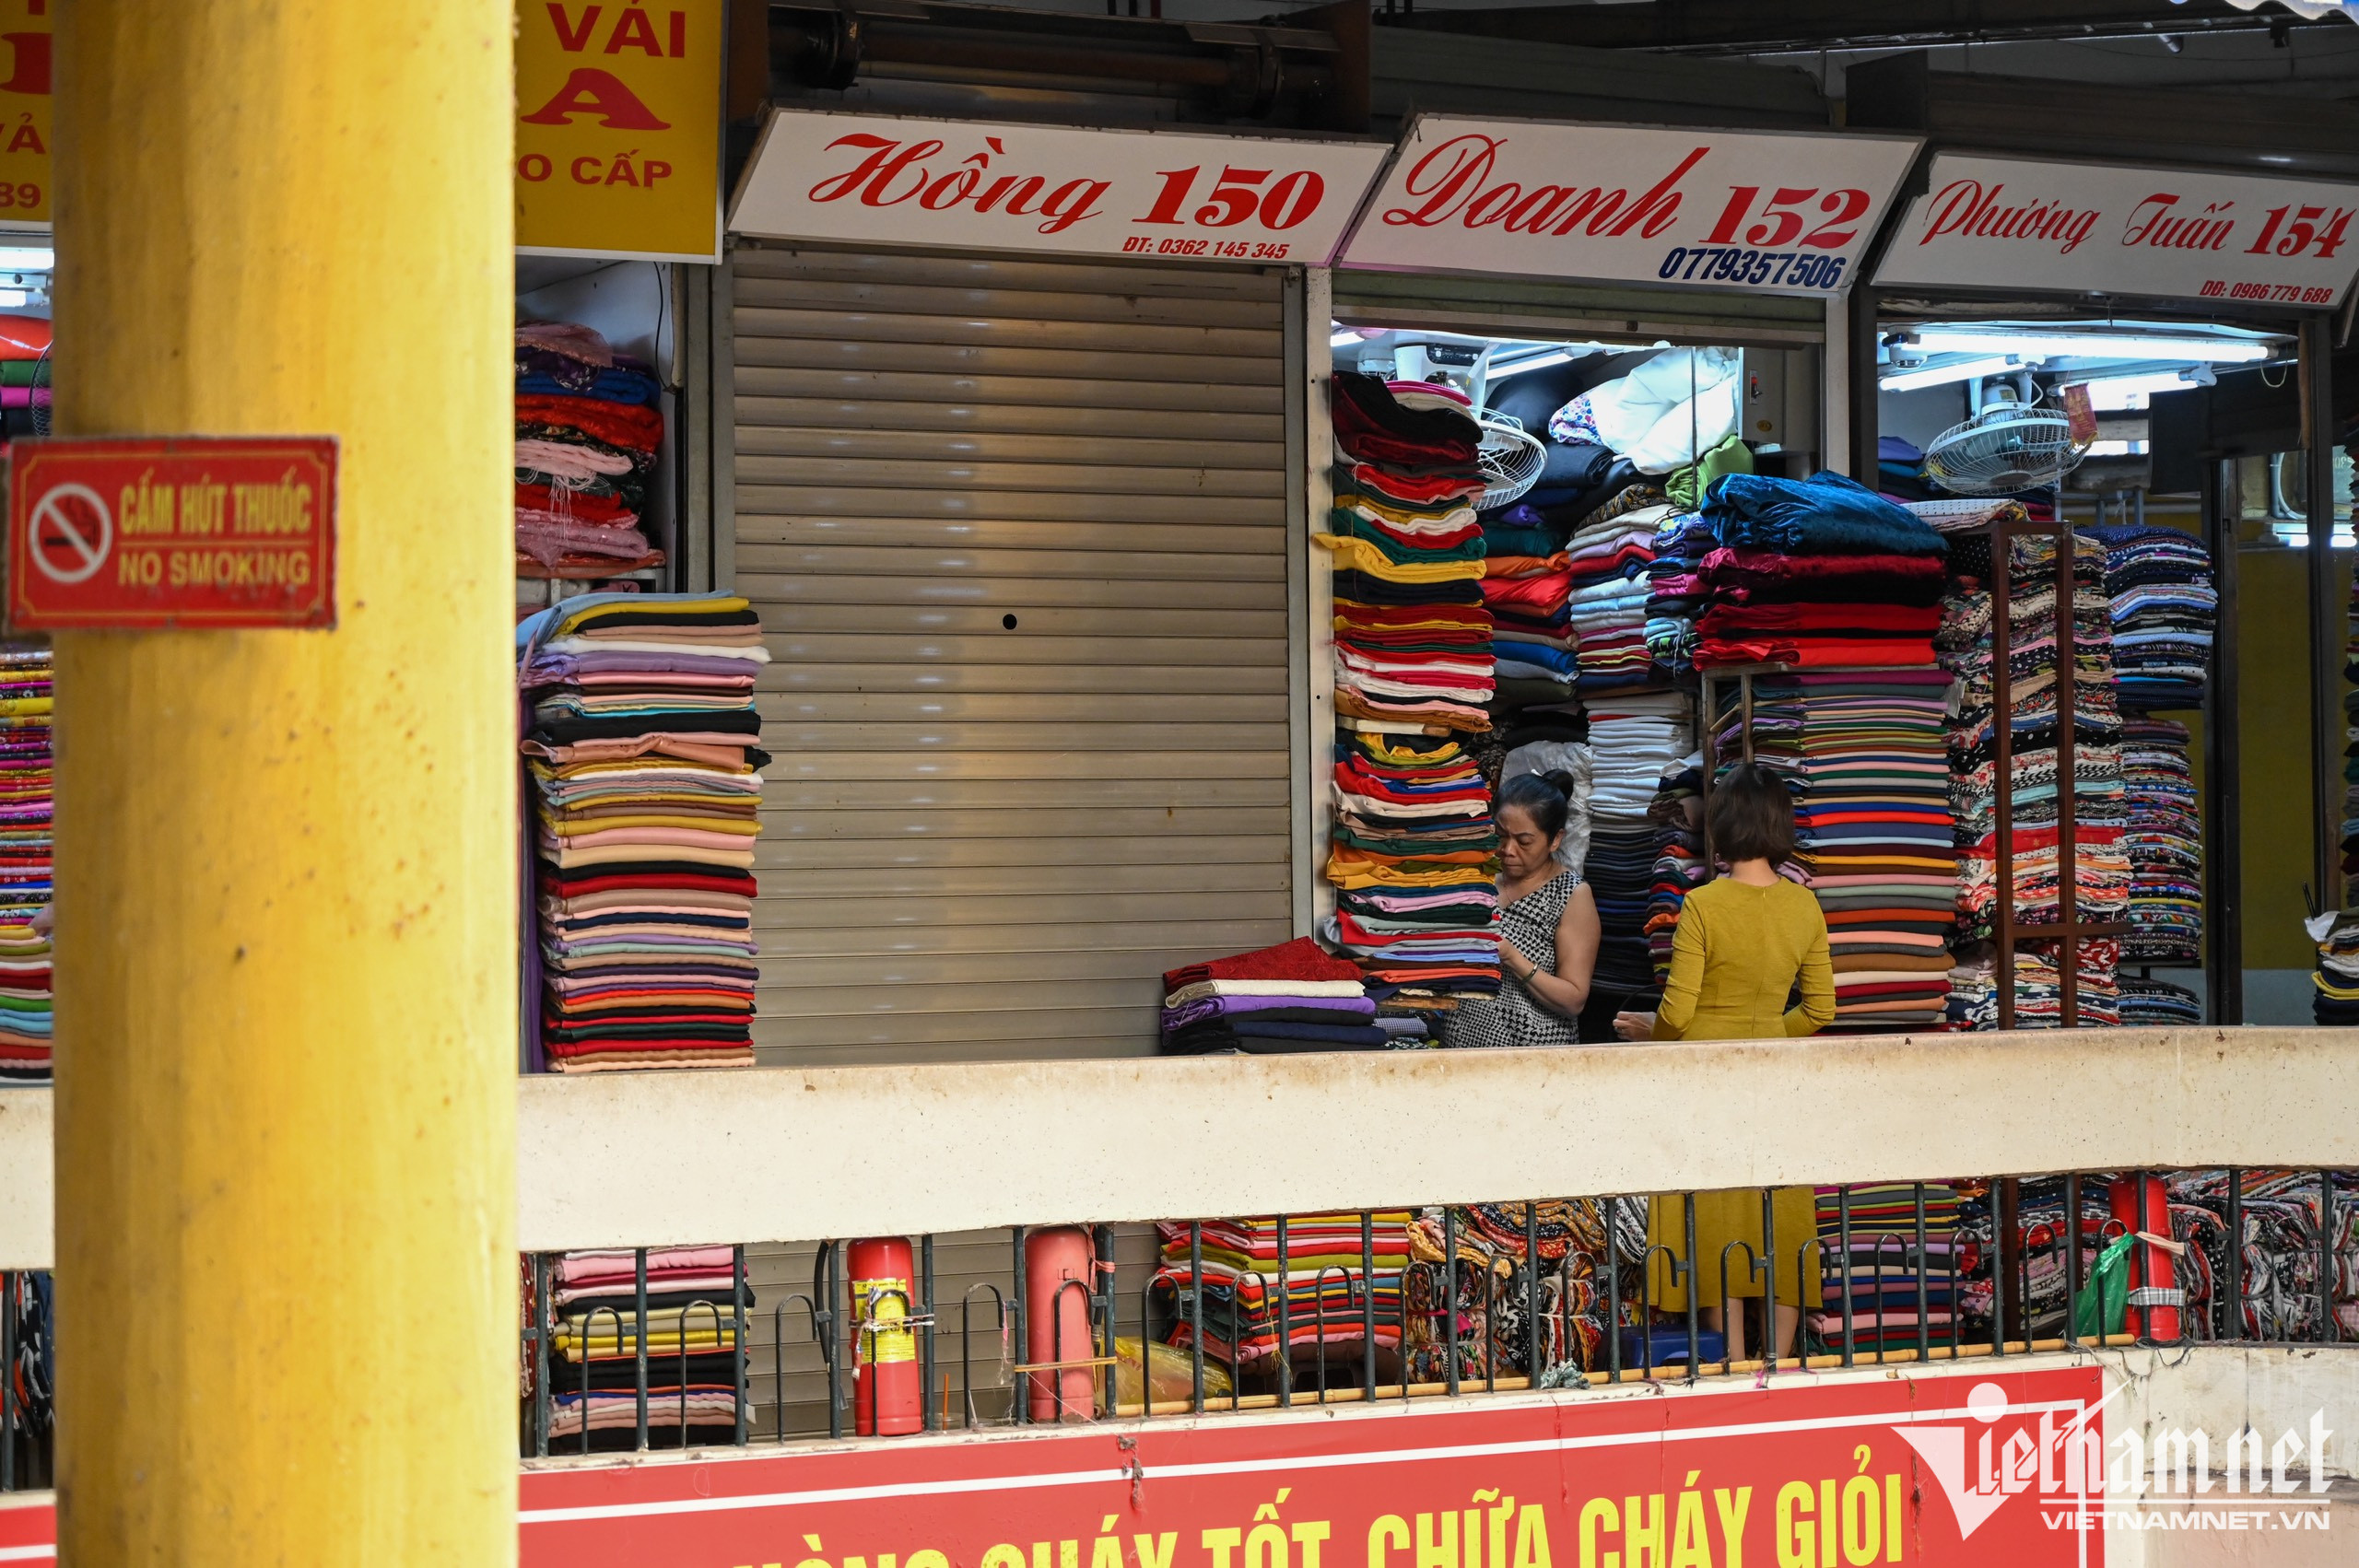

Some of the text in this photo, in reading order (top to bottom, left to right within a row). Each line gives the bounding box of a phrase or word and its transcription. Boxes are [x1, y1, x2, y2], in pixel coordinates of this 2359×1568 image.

[570, 148, 673, 190] CẤP
[808, 133, 1325, 235] Hồng 150
[1382, 134, 1872, 249] Doanh 152
[1122, 236, 1291, 259] ĐT: 0362 145 345
[2244, 204, 2357, 258] 154
[1659, 247, 1847, 289] 0779357506
[2230, 282, 2271, 299] 0986
[2271, 285, 2302, 301] 779
[2302, 287, 2333, 303] 688
[119, 465, 312, 534] CẤM HÚT THUỐC
[118, 552, 311, 587] NO SMOKING
[1368, 1488, 1552, 1568] CHỮA
[1579, 1470, 1753, 1568] CHÁY
[1776, 1444, 1902, 1568] GIỎI
